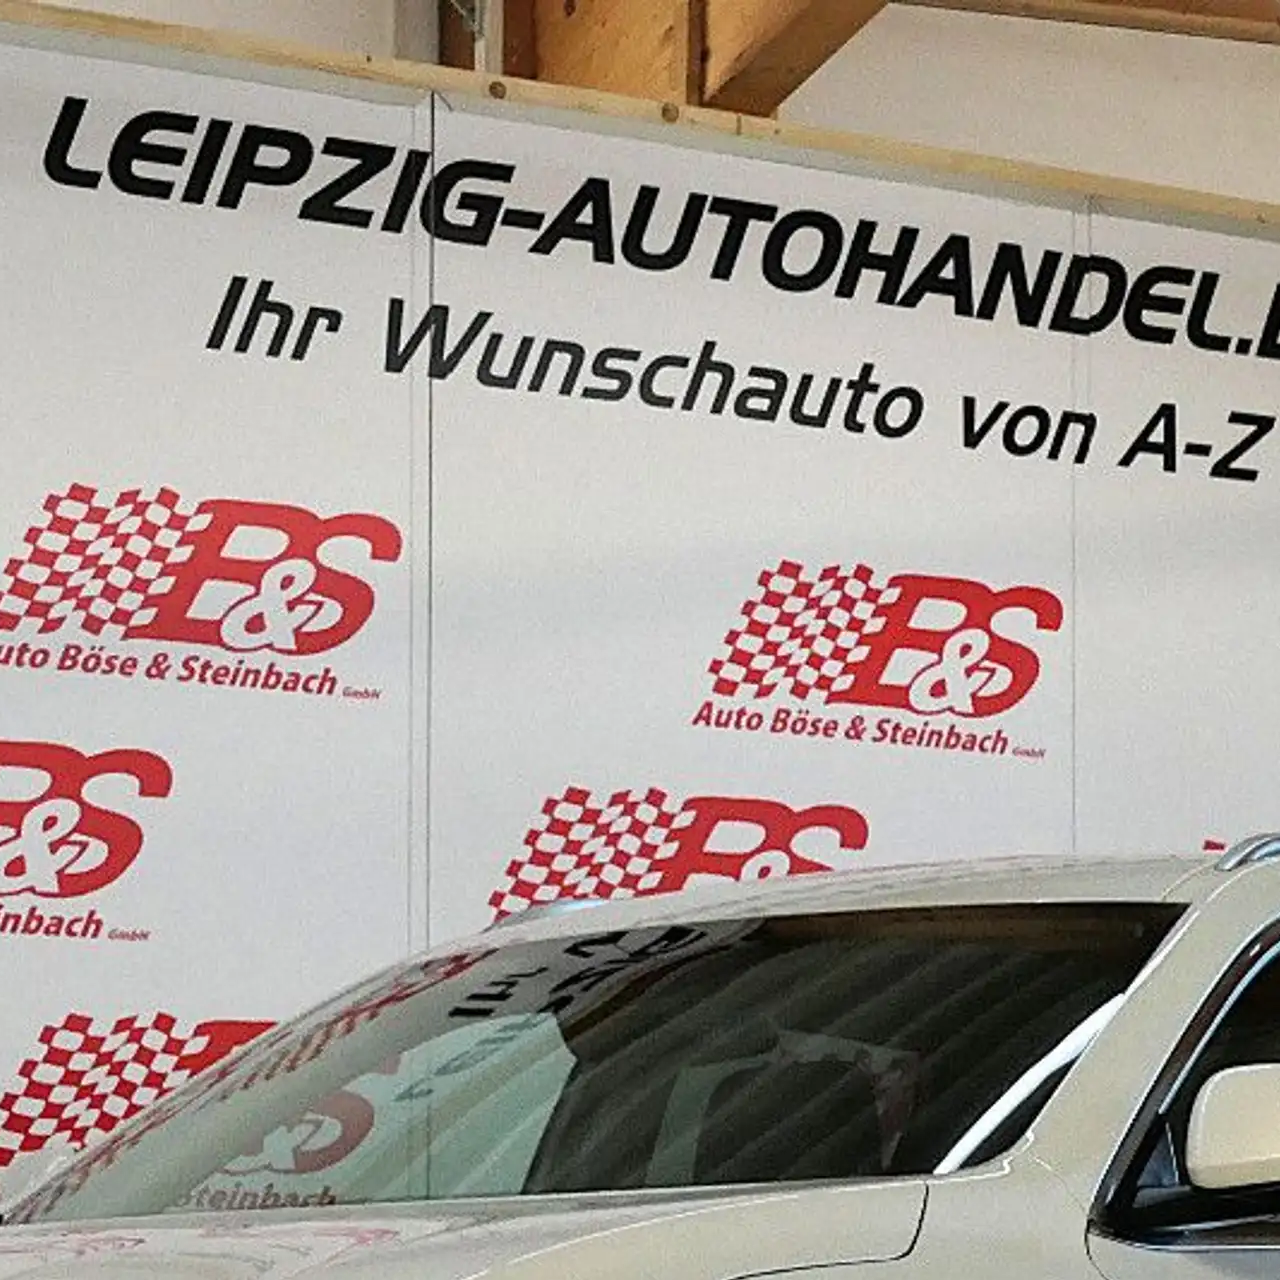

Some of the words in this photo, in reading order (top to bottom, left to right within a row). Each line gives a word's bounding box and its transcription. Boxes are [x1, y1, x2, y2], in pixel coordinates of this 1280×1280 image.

[206, 276, 342, 361] Ihr
[385, 298, 923, 438] Wunschauto
[962, 397, 1096, 464] von
[1118, 403, 1276, 481] A-Z
[122, 497, 404, 657] B&S
[824, 572, 1064, 719] B&S
[57, 644, 137, 676] Böse
[145, 653, 171, 679] &
[177, 656, 336, 694] Steinbach
[693, 702, 763, 730] Auto
[770, 709, 838, 737] Böse
[845, 716, 866, 740] &
[872, 719, 1008, 754] Steinbach
